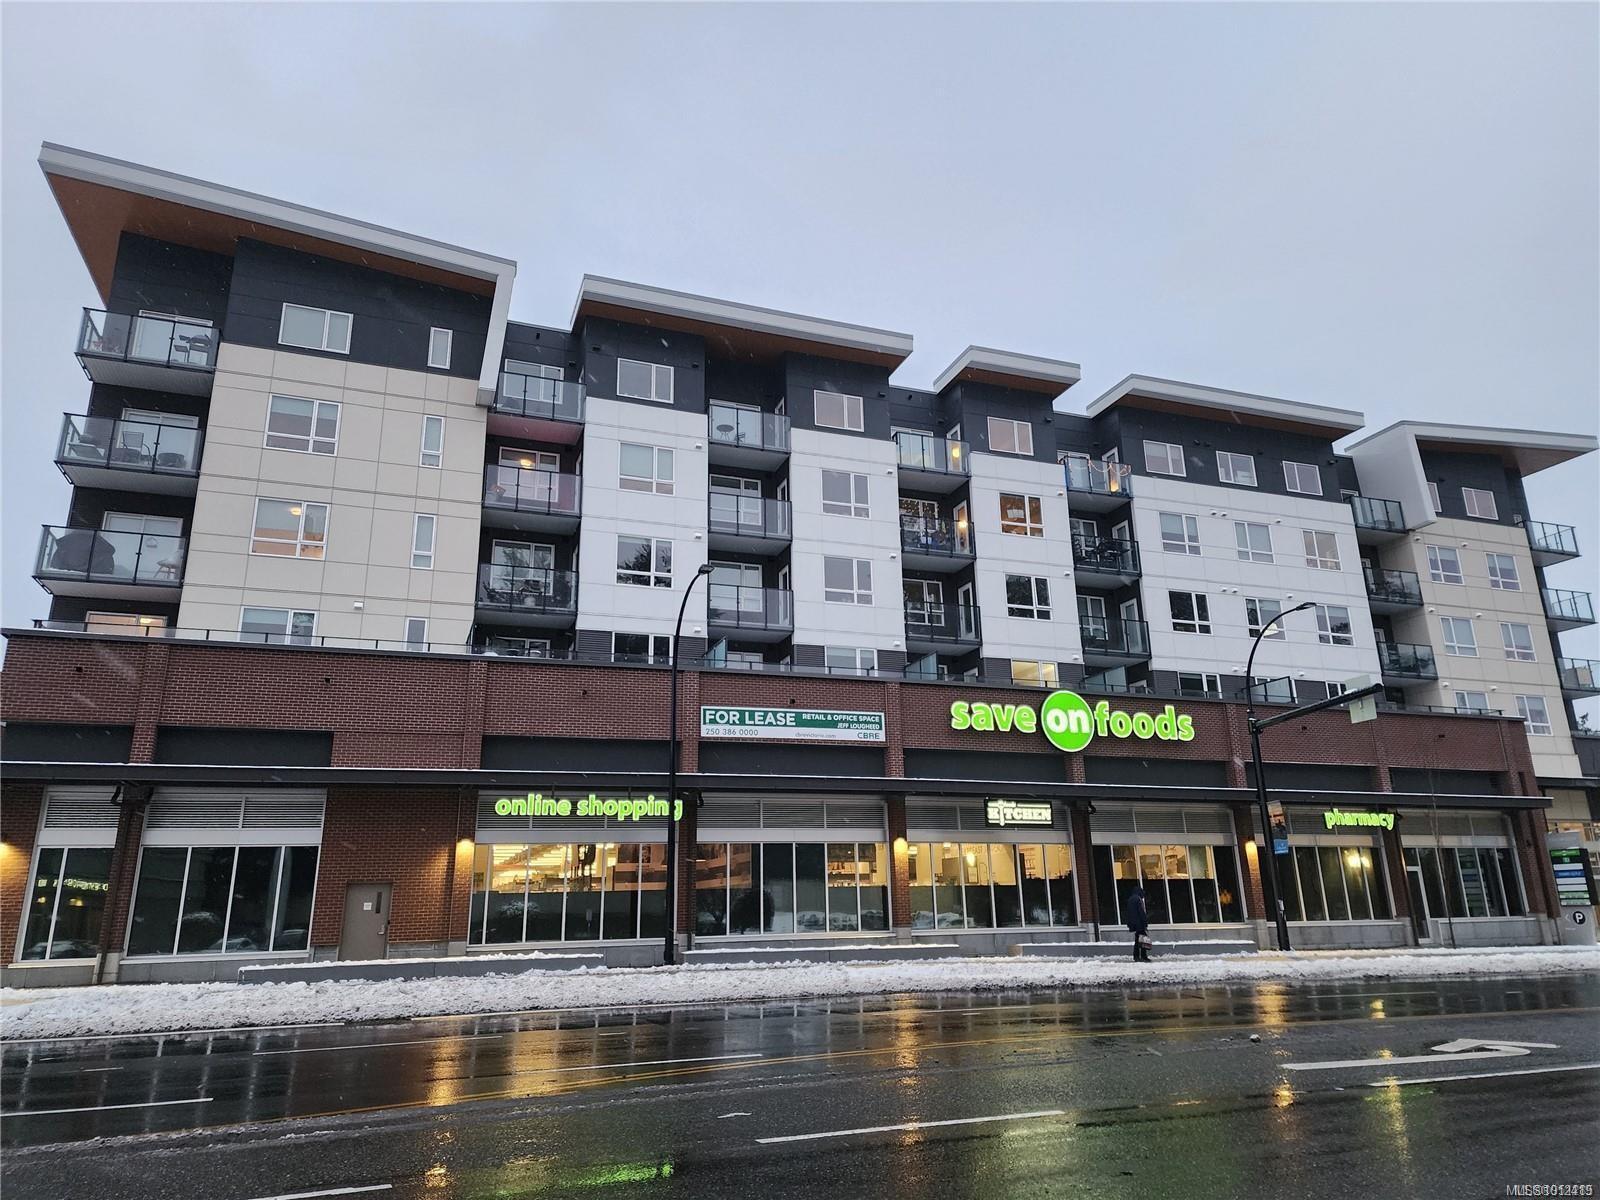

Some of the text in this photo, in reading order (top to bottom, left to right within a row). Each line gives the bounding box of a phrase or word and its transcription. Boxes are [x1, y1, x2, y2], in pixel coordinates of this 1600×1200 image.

[705, 710, 796, 726] FOR LEASE
[802, 713, 826, 721] RETAIL
[950, 700, 1196, 742] save on foods
[722, 728, 737, 736] 386
[857, 732, 880, 740] CBRE
[494, 793, 684, 822] online shopping
[1323, 807, 1395, 831] pharmacy
[1575, 912, 1584, 924] P
